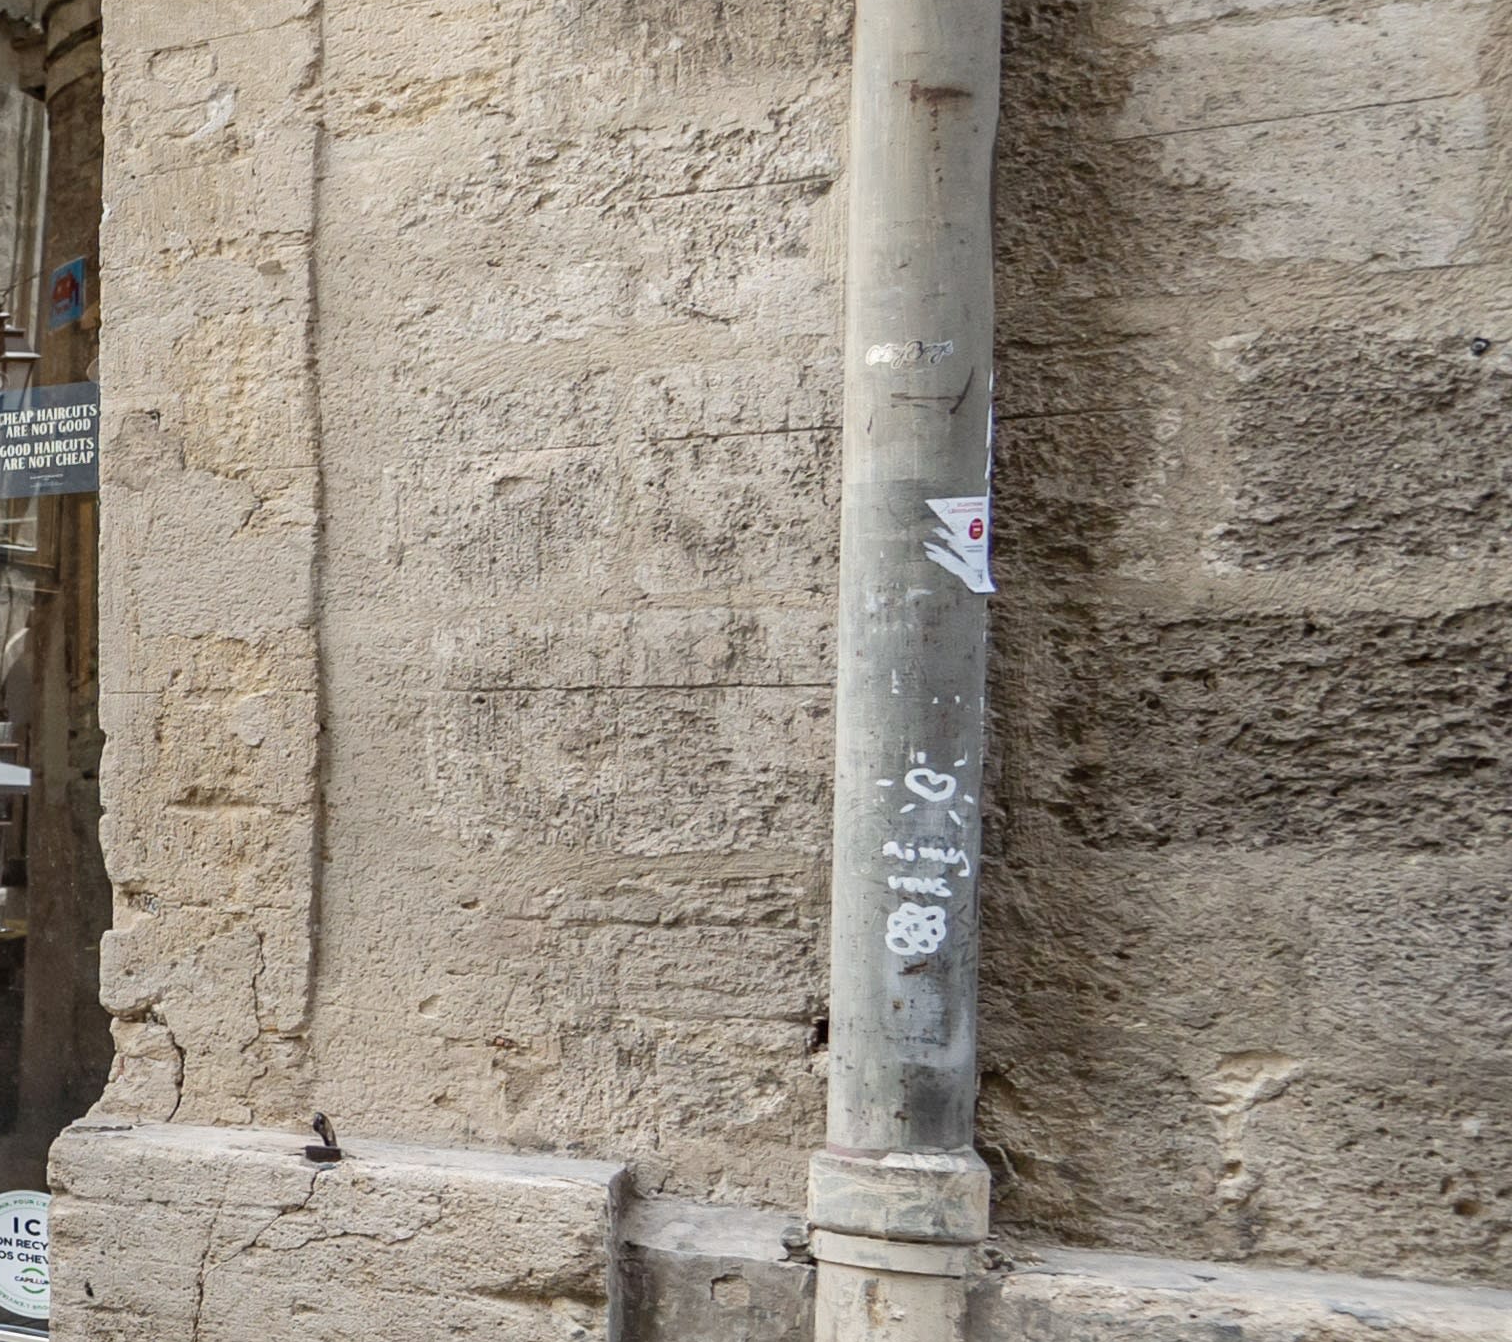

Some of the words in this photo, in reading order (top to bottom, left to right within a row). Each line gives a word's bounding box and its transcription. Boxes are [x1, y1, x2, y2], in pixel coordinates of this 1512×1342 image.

[36, 403, 97, 421] HAIRCUTS
[5, 425, 28, 438] ARE
[31, 421, 56, 436] NOT
[58, 418, 91, 433] GOOD
[0, 442, 31, 458] GOOD
[34, 437, 94, 455] HAIRCUTS
[3, 457, 25, 471] ARE
[28, 454, 54, 469] NOT
[55, 451, 94, 466] CHEAP
[13, 1216, 49, 1236] IC
